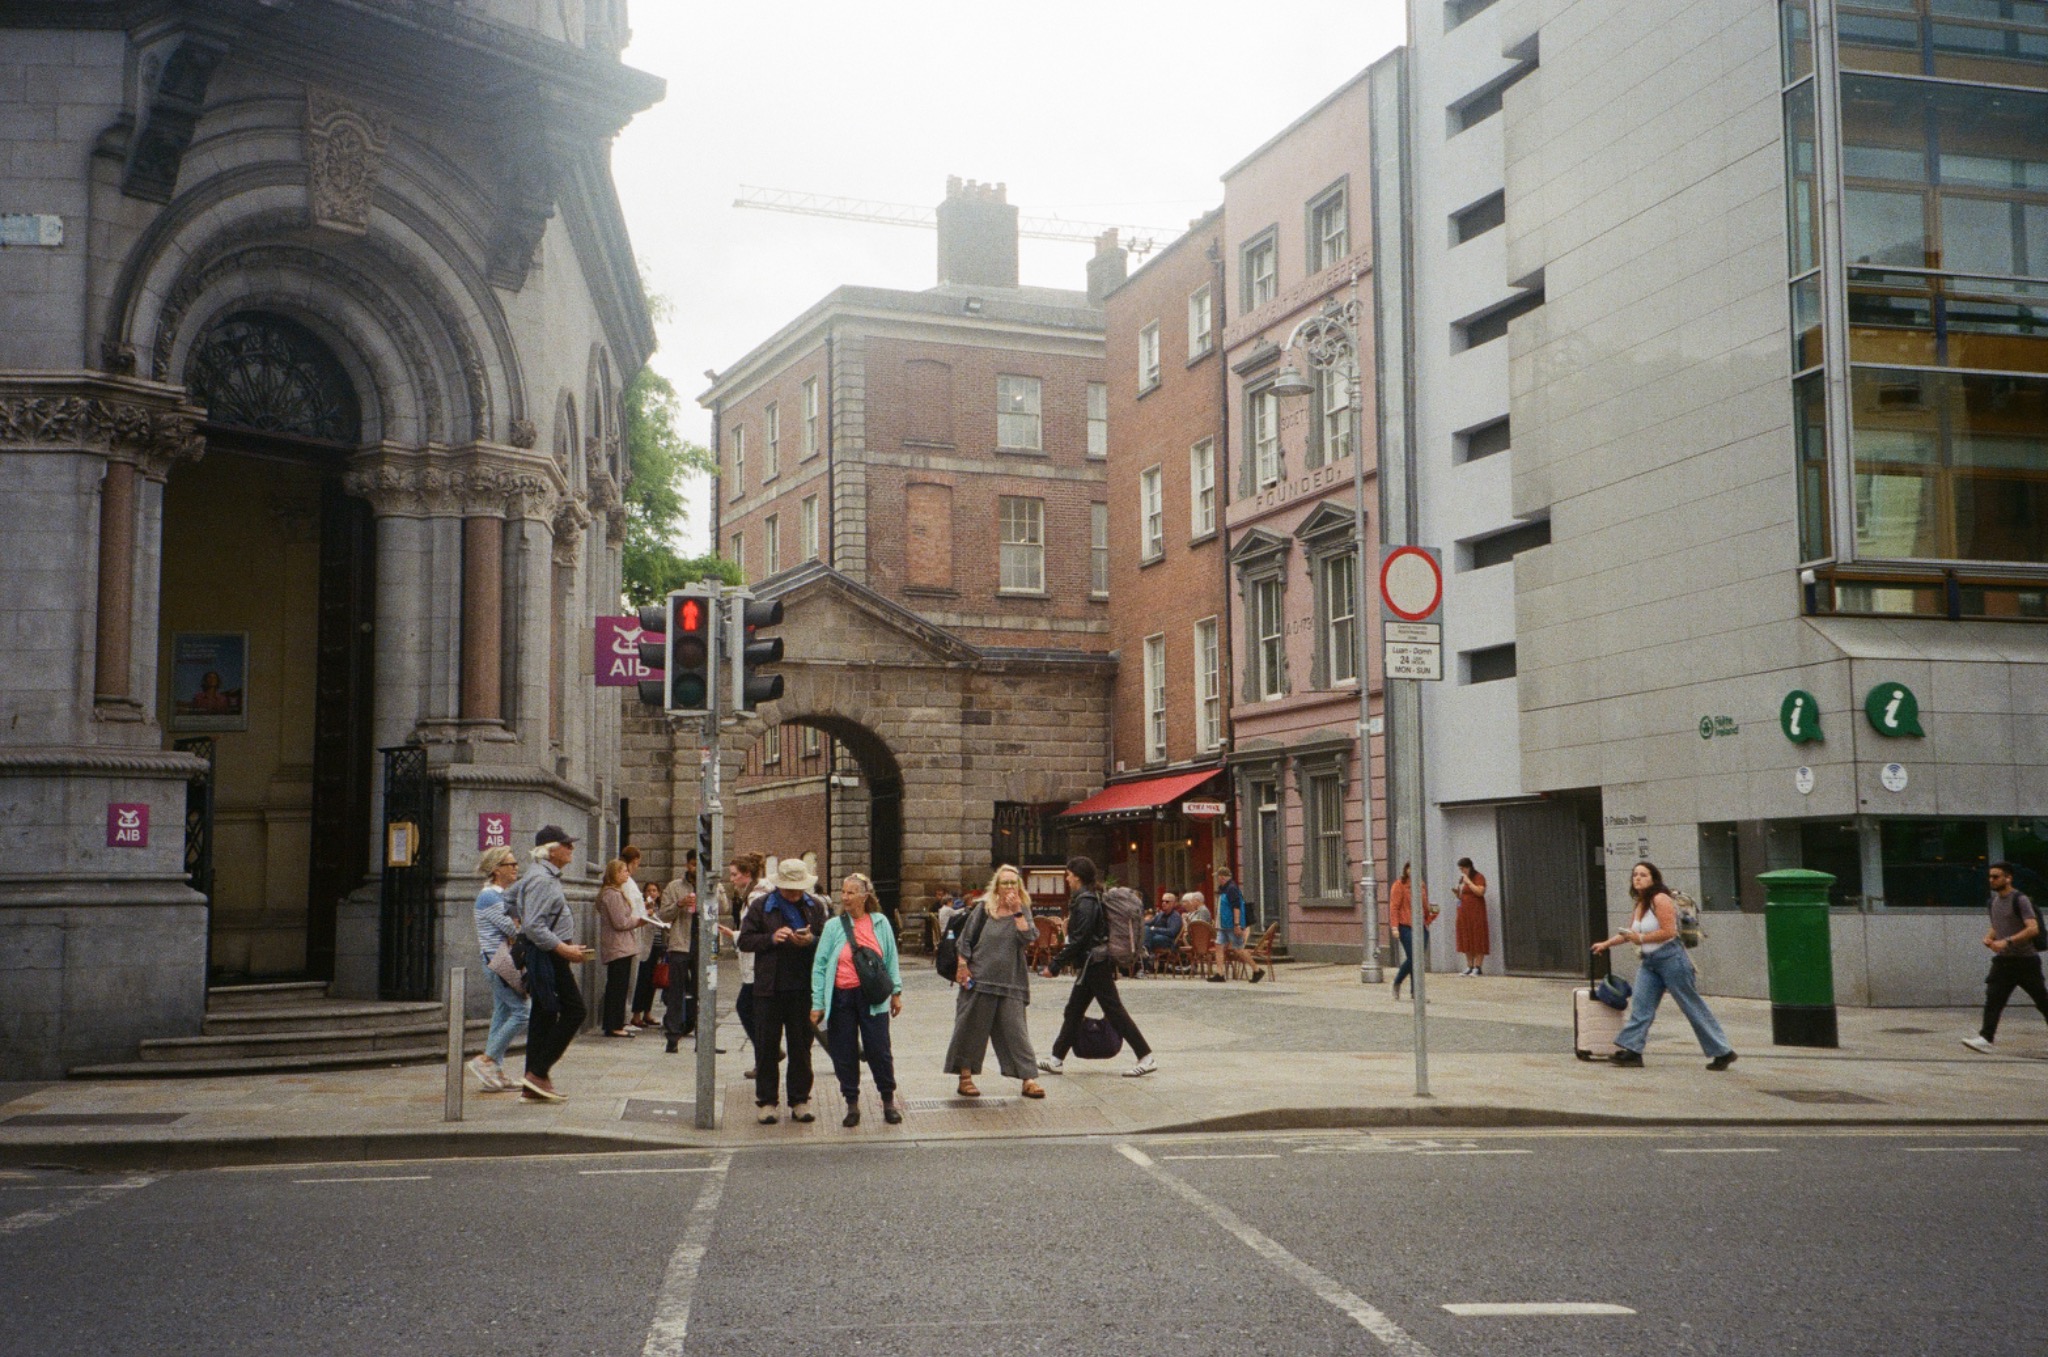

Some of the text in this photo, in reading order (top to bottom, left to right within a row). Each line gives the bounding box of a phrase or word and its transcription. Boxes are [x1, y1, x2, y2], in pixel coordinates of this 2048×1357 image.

[1400, 655, 1410, 665] 24
[609, 658, 651, 676] AIB
[1394, 666, 1412, 674] MON
[116, 829, 141, 841] AIB
[485, 835, 505, 847] AIB
